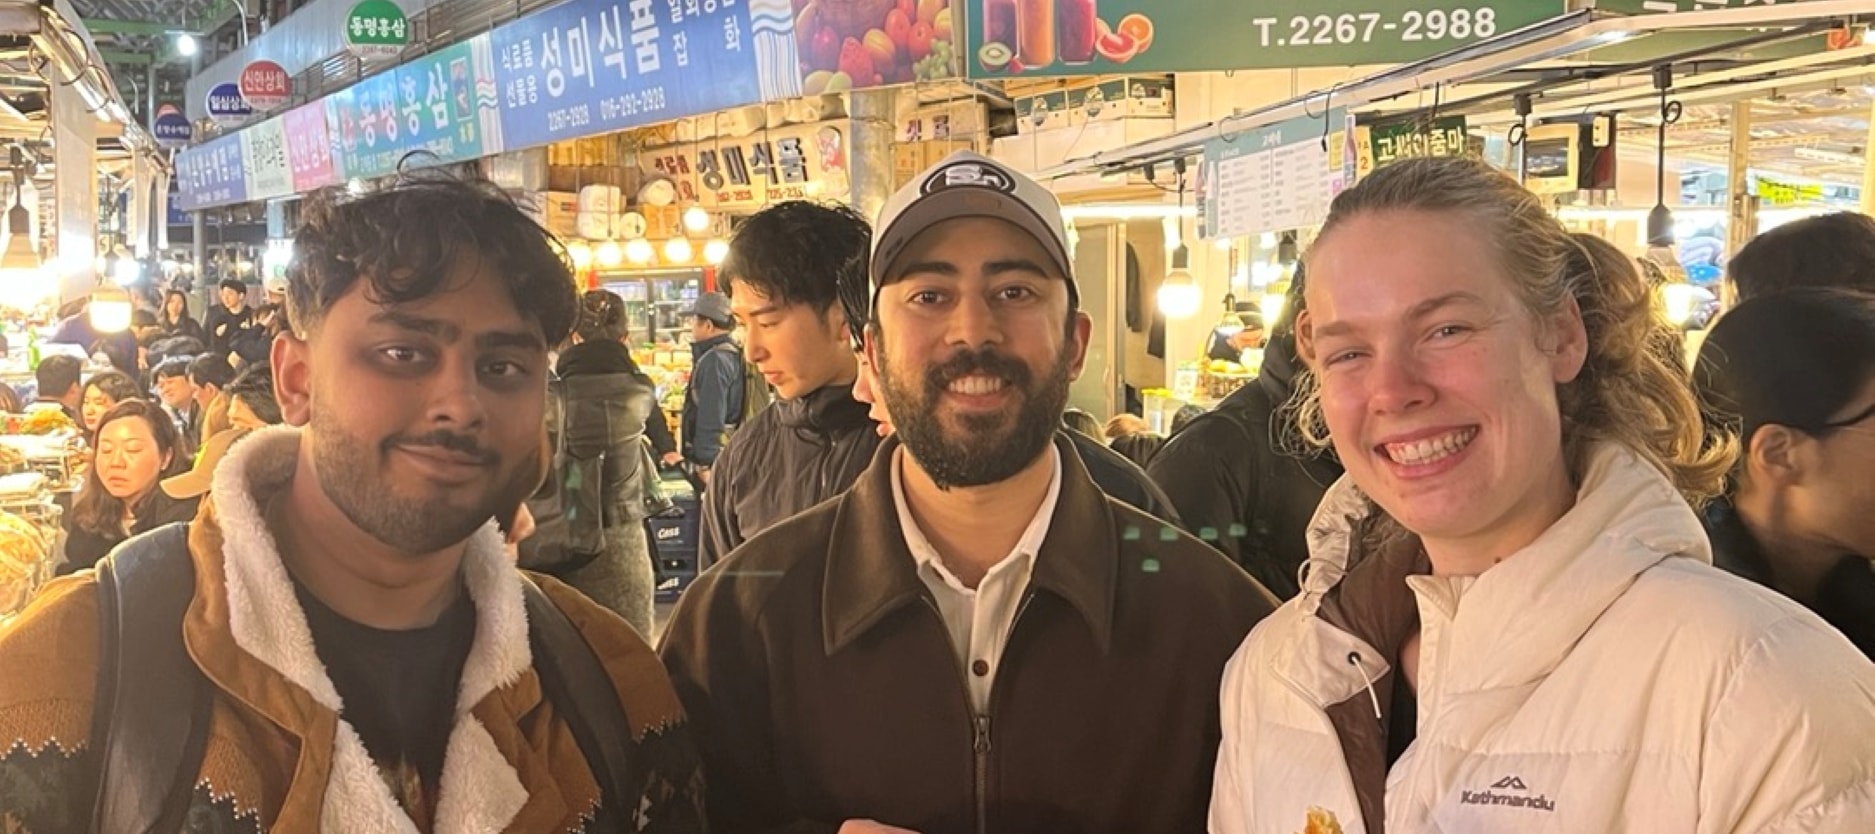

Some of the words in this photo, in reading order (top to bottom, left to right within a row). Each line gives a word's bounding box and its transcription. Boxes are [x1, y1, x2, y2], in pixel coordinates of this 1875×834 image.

[350, 16, 405, 38] 동명홍삼
[541, 0, 660, 97] 성미식품
[1253, 7, 1496, 46] T.2267-2988
[359, 62, 448, 148] 동명홍삼
[696, 137, 808, 190] 성미식품
[1461, 790, 1555, 811] Kathmandu
